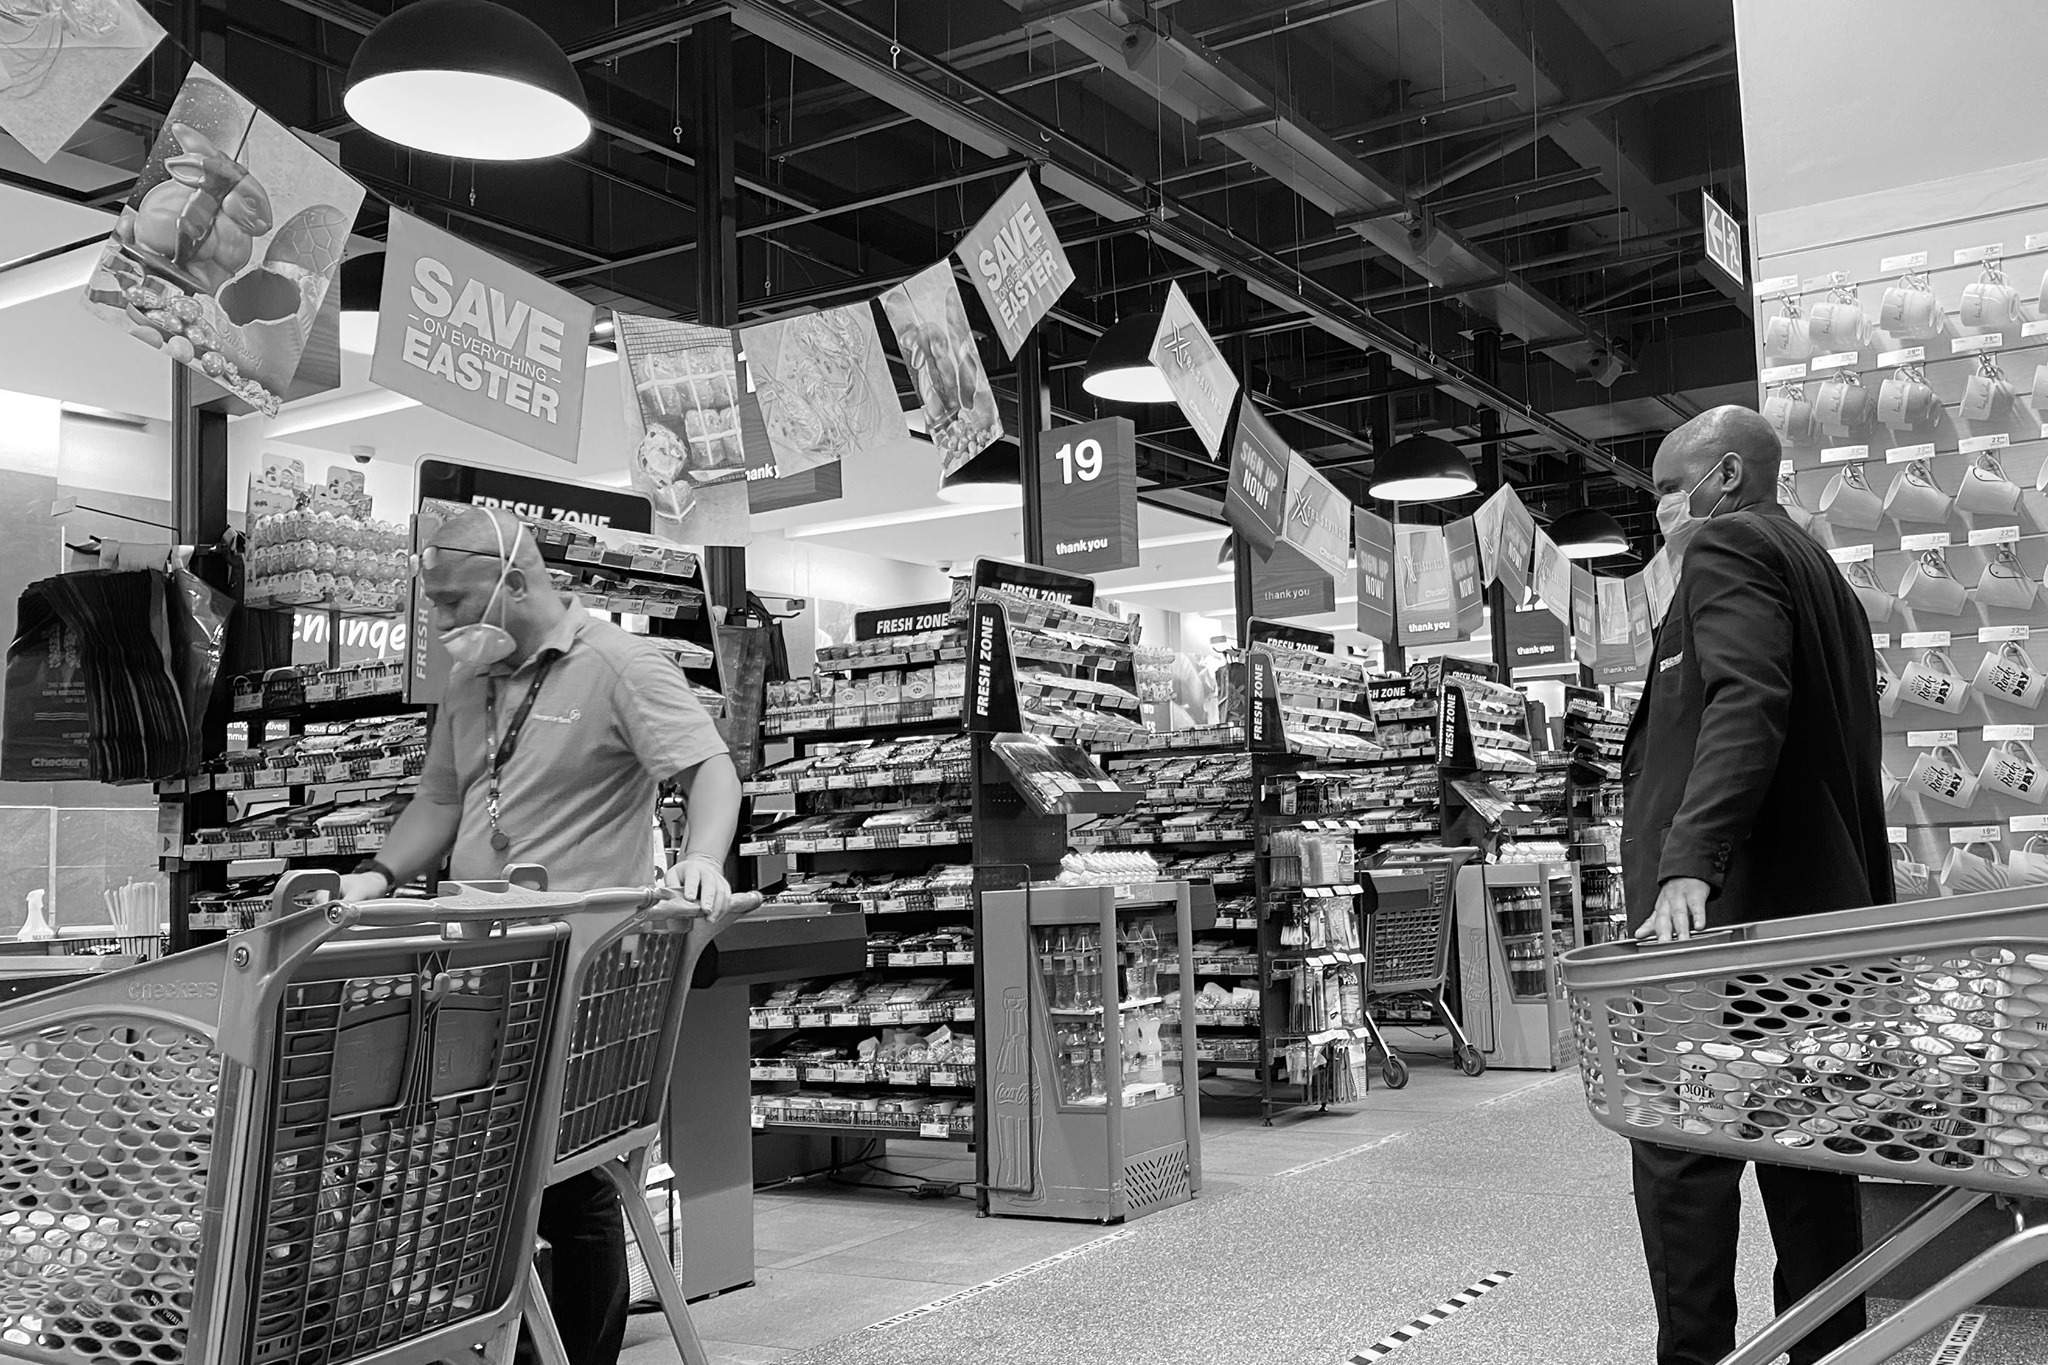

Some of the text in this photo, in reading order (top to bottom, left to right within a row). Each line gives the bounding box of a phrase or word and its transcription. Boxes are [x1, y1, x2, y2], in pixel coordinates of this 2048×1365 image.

[979, 202, 1042, 291] SAVE
[999, 249, 1058, 330] EASTER
[410, 257, 564, 371] SAVE
[423, 318, 547, 382] ON EVERYTHING
[402, 326, 560, 424] EASTER
[745, 464, 773, 481] ank
[1055, 439, 1102, 484] 19
[1241, 441, 1278, 491] SIGN UP
[1242, 469, 1269, 510] NOW!
[1056, 538, 1108, 555] thank you
[1360, 551, 1388, 579] SIGN UP
[1041, 590, 1072, 604] ZONE
[1264, 587, 1310, 600] thank you
[1365, 574, 1384, 600] NOW!
[876, 612, 949, 635] FRESH ZONE
[1408, 621, 1450, 633] thank you
[416, 608, 428, 679] FRESH
[980, 616, 993, 658] ZONE
[1517, 645, 1554, 655] thank you
[1623, 664, 1636, 673] you
[1995, 665, 2015, 692] Rock
[977, 661, 992, 717] FRESH
[1381, 687, 1406, 697] ZONE
[1918, 675, 1937, 700] Rock
[1935, 679, 1950, 705] DAY
[2012, 671, 2029, 697] DAY
[1254, 664, 1263, 741] FRESH ZONE
[305, 724, 325, 732] focus
[1445, 694, 1456, 758] FRESH ZONE
[31, 758, 88, 767] Checkers
[2000, 760, 2021, 787] Rock
[1929, 766, 1949, 792] Rock
[1945, 772, 1962, 798] DAY
[2018, 766, 2035, 792] DAY
[127, 980, 217, 999] Checkers
[861, 1117, 891, 1126] mentos
[899, 1119, 920, 1127] ment
[931, 1285, 991, 1306] CAUTION
[1950, 1316, 1981, 1343] CAUTION
